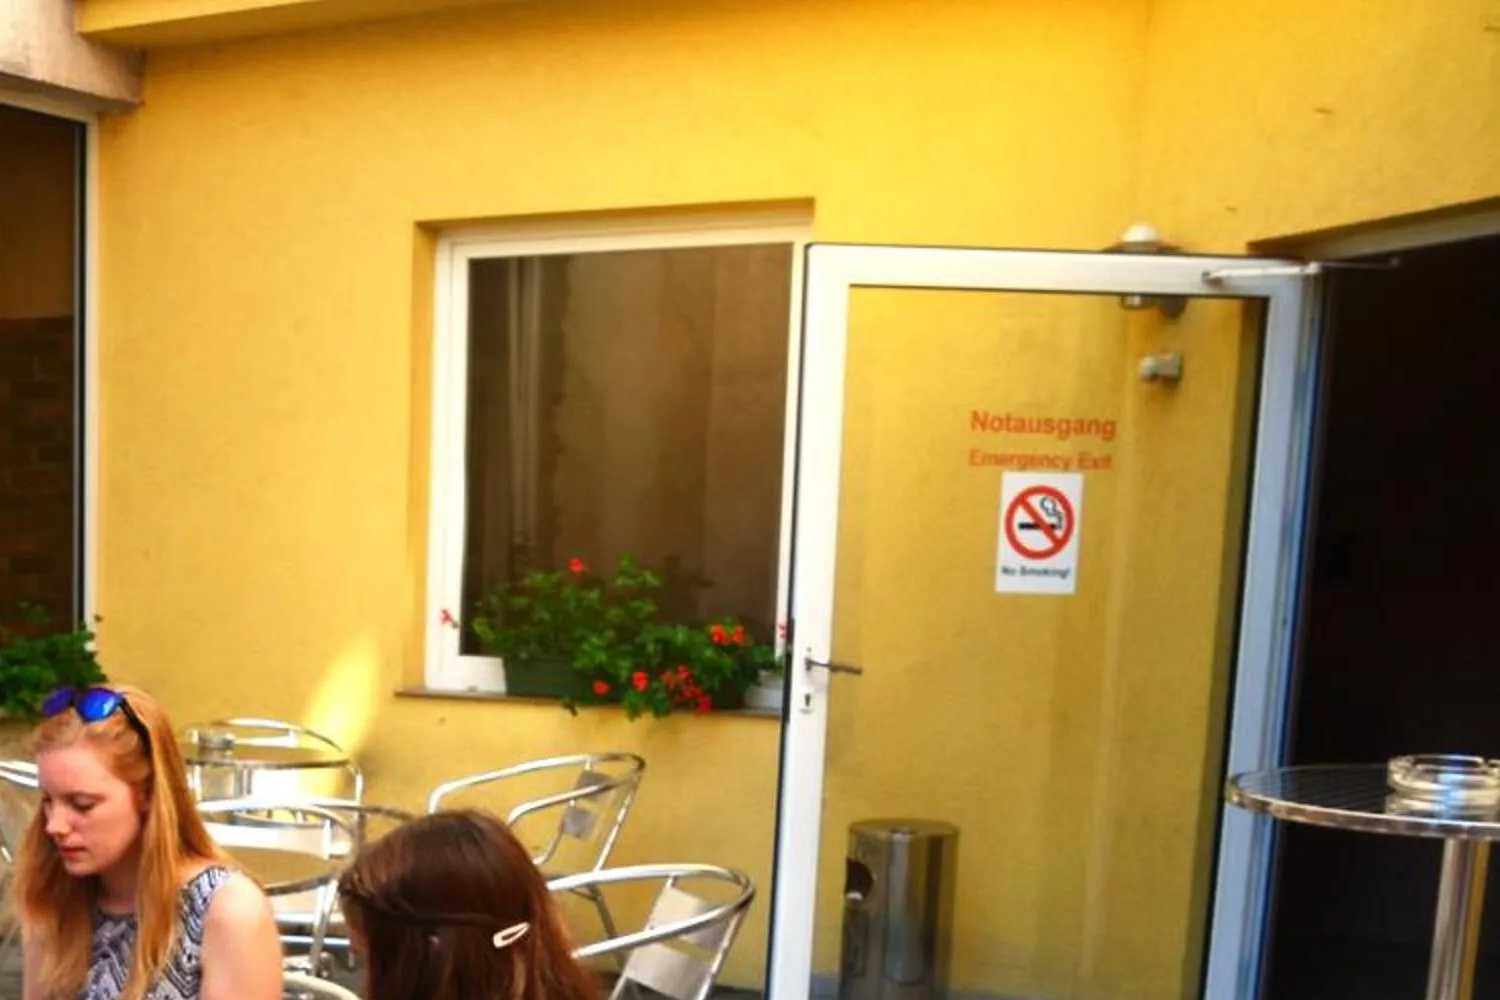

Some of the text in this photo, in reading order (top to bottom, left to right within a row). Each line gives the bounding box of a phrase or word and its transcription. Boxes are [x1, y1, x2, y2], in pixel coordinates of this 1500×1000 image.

[970, 410, 1117, 441] Notausgang
[969, 448, 1113, 471] Emergency Exit
[1002, 565, 1017, 576] No
